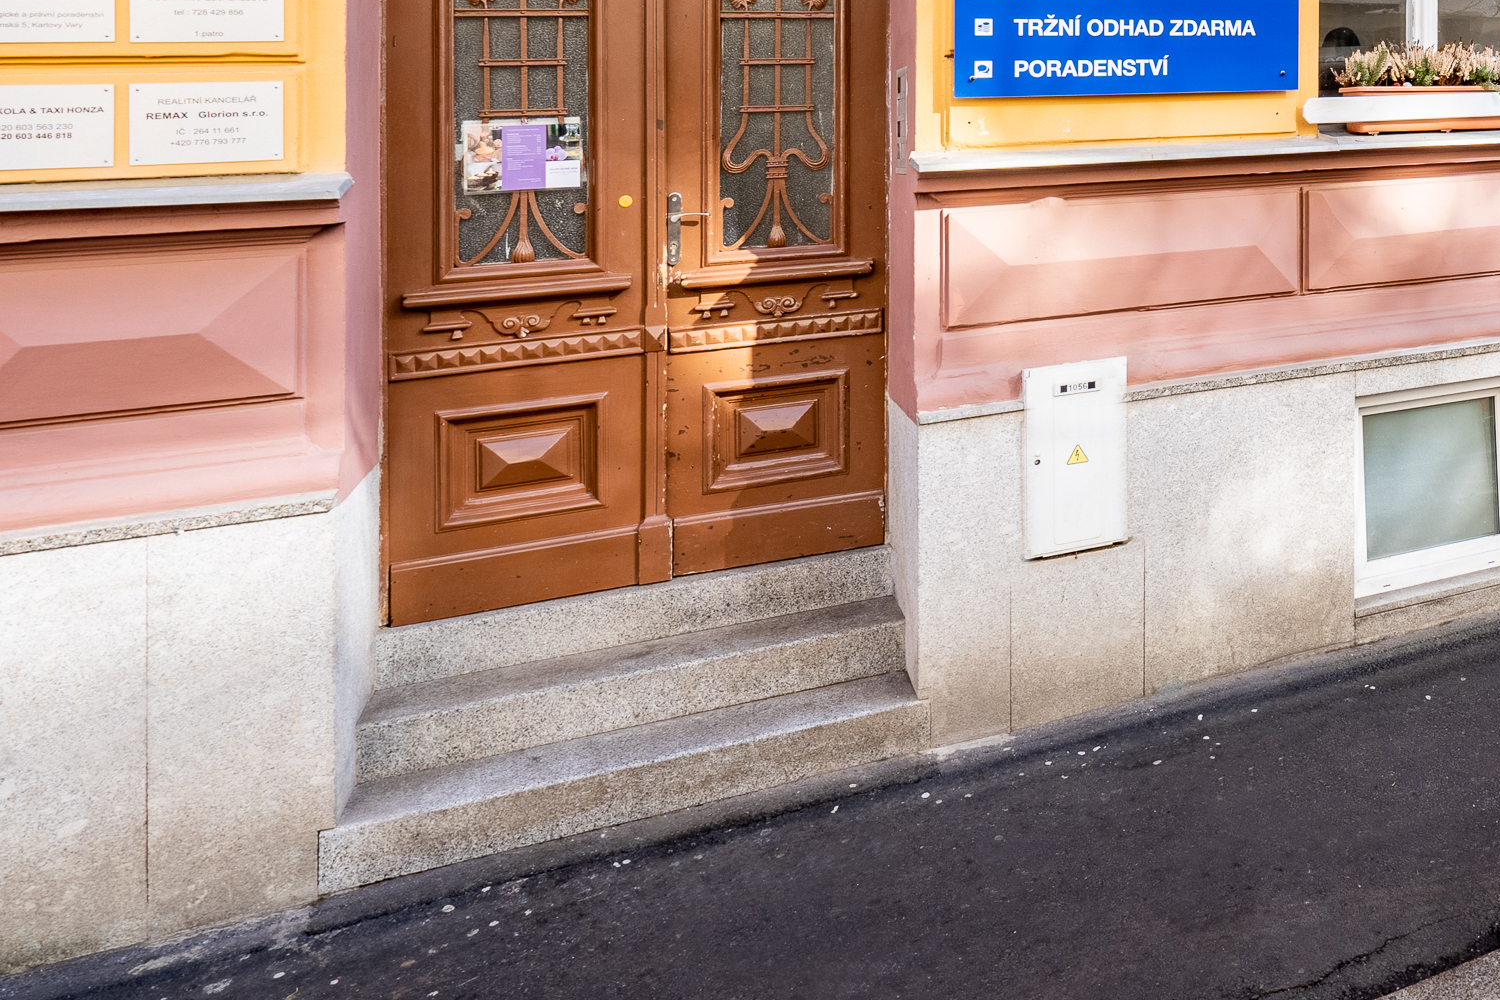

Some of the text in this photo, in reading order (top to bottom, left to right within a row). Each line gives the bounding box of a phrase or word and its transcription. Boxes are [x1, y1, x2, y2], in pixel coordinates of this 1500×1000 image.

[1014, 14, 1256, 36] TRŽNÍ ODHAD ZDARMA
[1014, 55, 1169, 78] PORADENSTVÍ
[157, 95, 257, 105] REALITNÍ KANCELÁŘ
[146, 112, 188, 120] REMAX
[198, 111, 238, 119] Glorion
[1068, 382, 1088, 391] 1056
